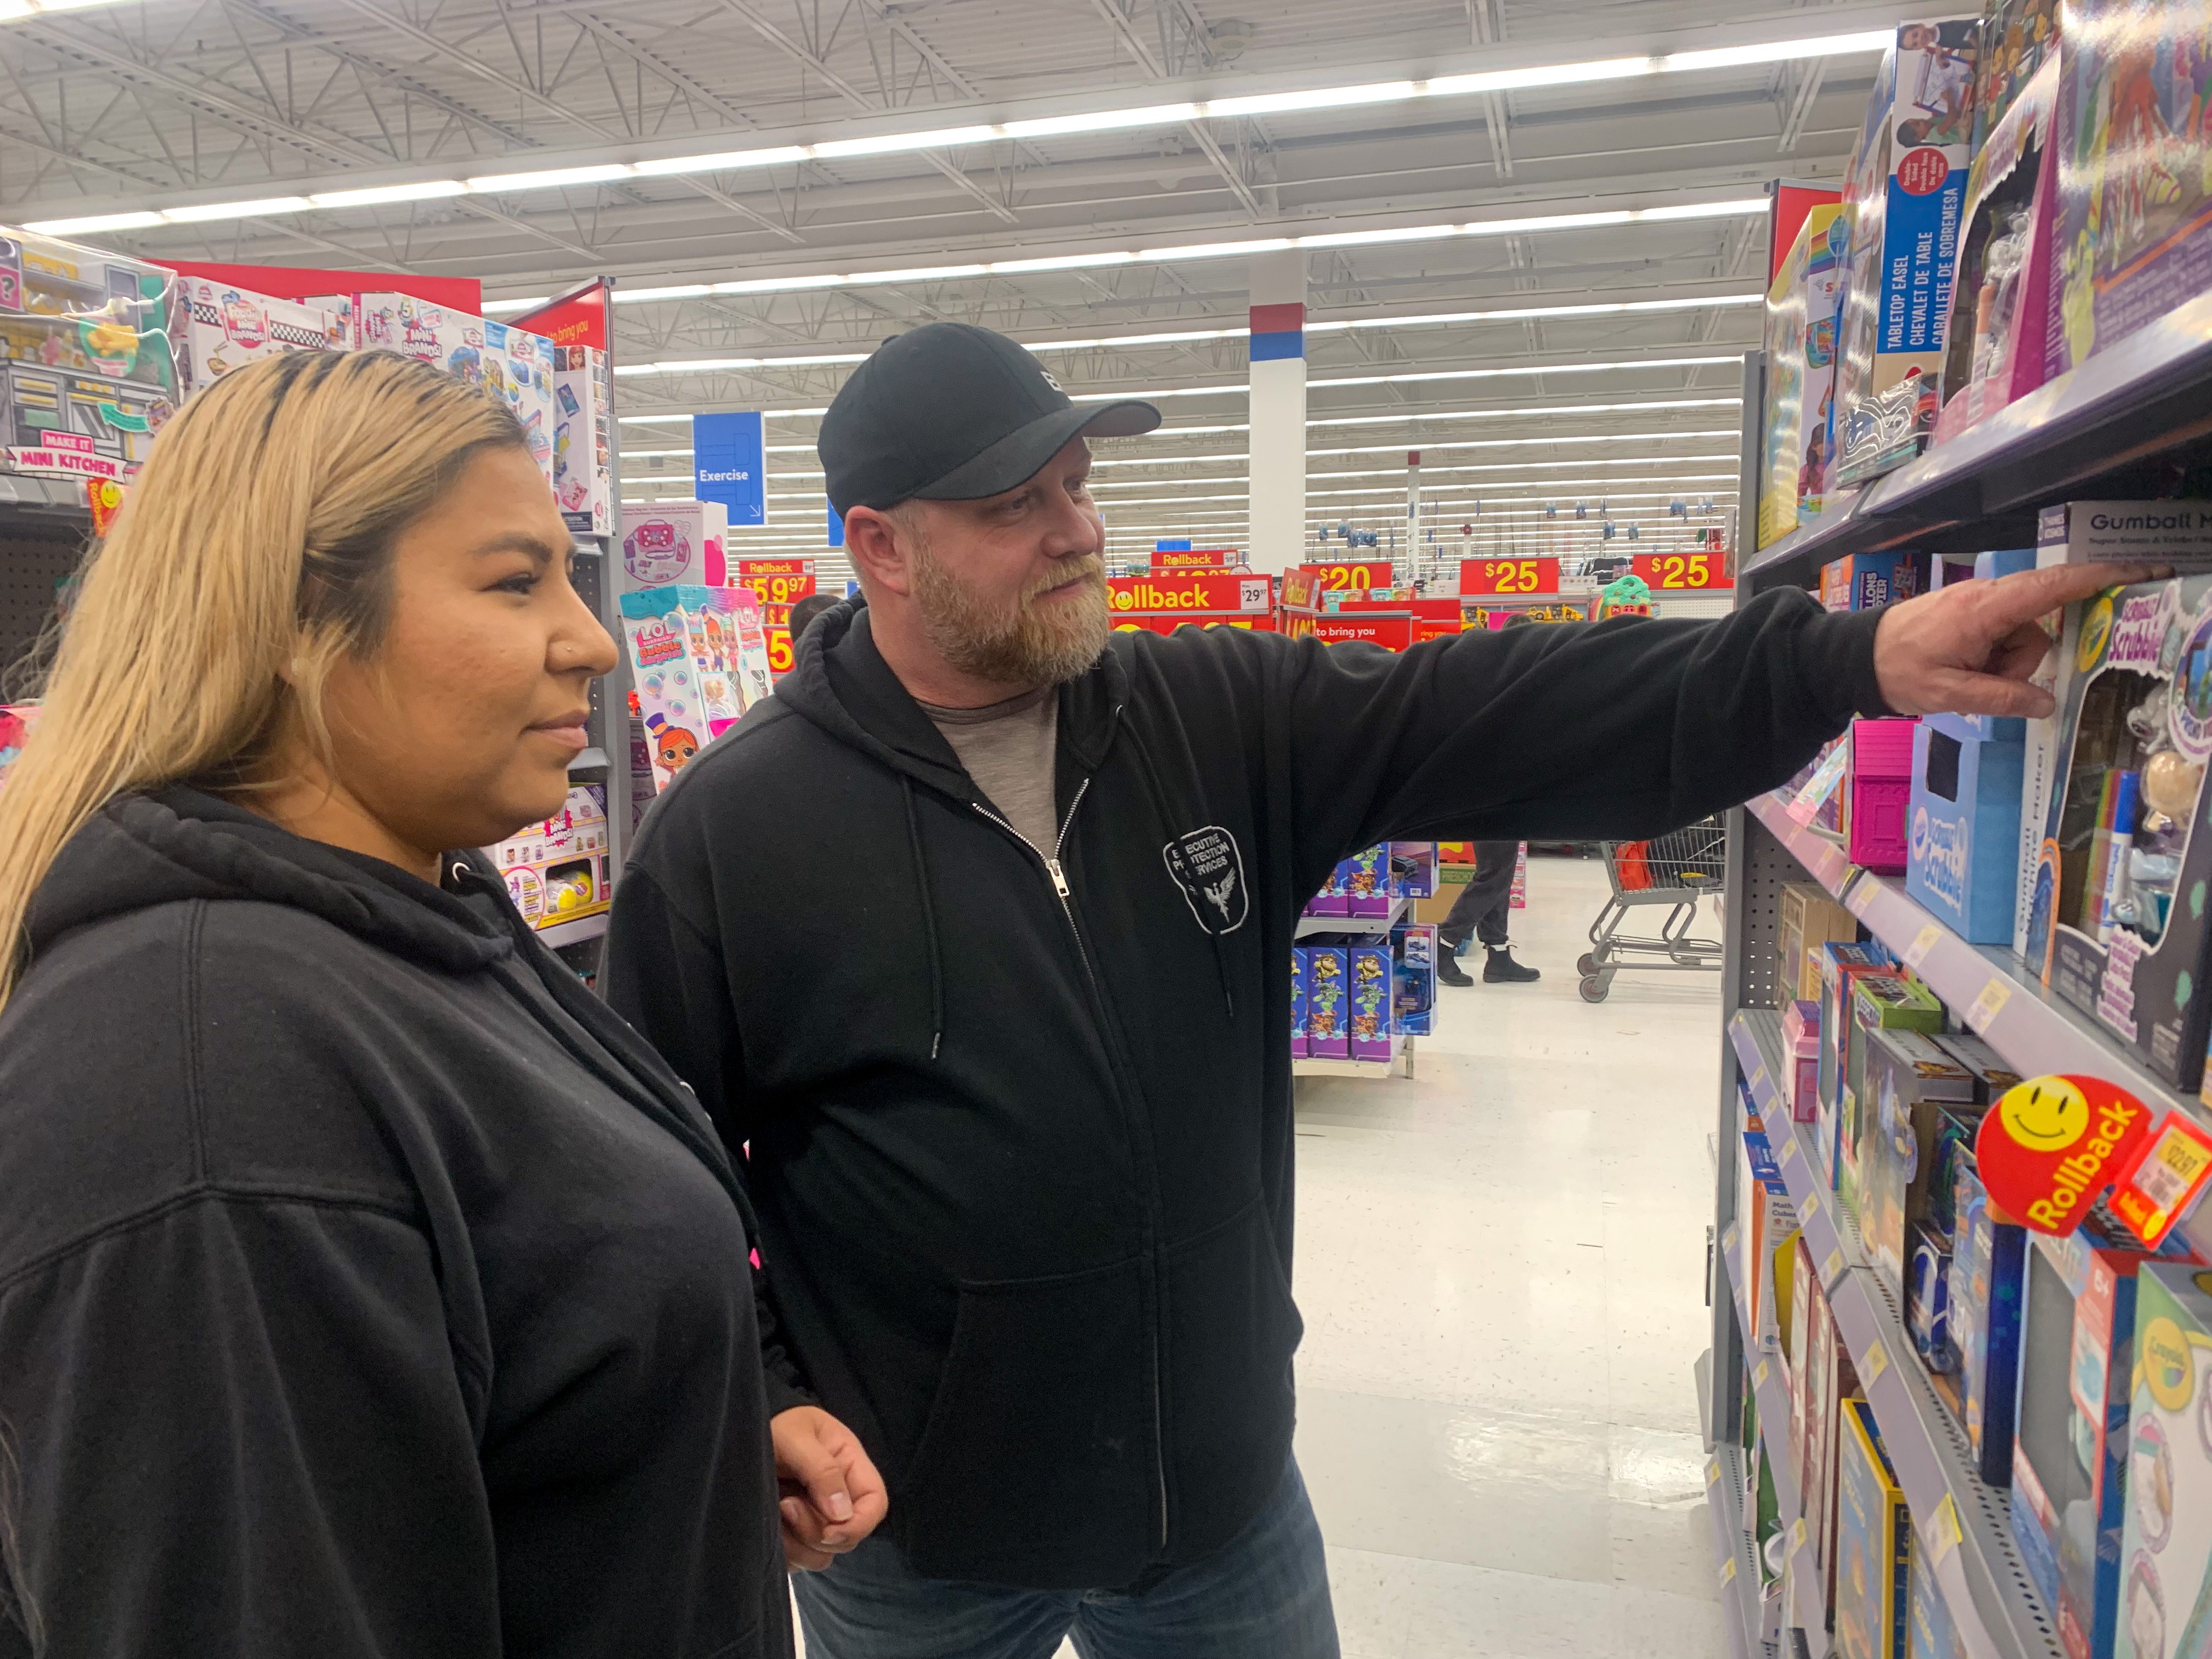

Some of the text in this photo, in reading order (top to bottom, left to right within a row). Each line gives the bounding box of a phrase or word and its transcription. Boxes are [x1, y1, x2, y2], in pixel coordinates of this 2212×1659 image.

[1939, 188, 1959, 259] SOBREMESA
[1937, 261, 1952, 277] DE
[1909, 231, 1933, 346] CHEVALET DE TABLE
[1888, 255, 1909, 349] TABLETOP EASEL
[558, 324, 575, 341] bring
[577, 320, 588, 339] you
[402, 341, 442, 357] BRANDS!
[46, 435, 90, 450] MAKE IT
[21, 452, 116, 476] MINI KITCHEN
[699, 470, 748, 481] Exercise
[2091, 513, 2191, 531] Gumball
[750, 563, 792, 573] Rollback
[1164, 554, 1212, 566] Rollback
[1319, 566, 1370, 590] $20
[1485, 561, 1538, 592] $25
[1651, 555, 1709, 588] $25
[1329, 627, 1355, 638] bring
[1357, 628, 1375, 639] you
[639, 641, 682, 657] Bubble
[2033, 743, 2045, 820] Maker
[545, 828, 574, 847] BRANDS!
[1172, 833, 1221, 859] EECUTIVE
[2028, 1101, 2138, 1229] Rollback
